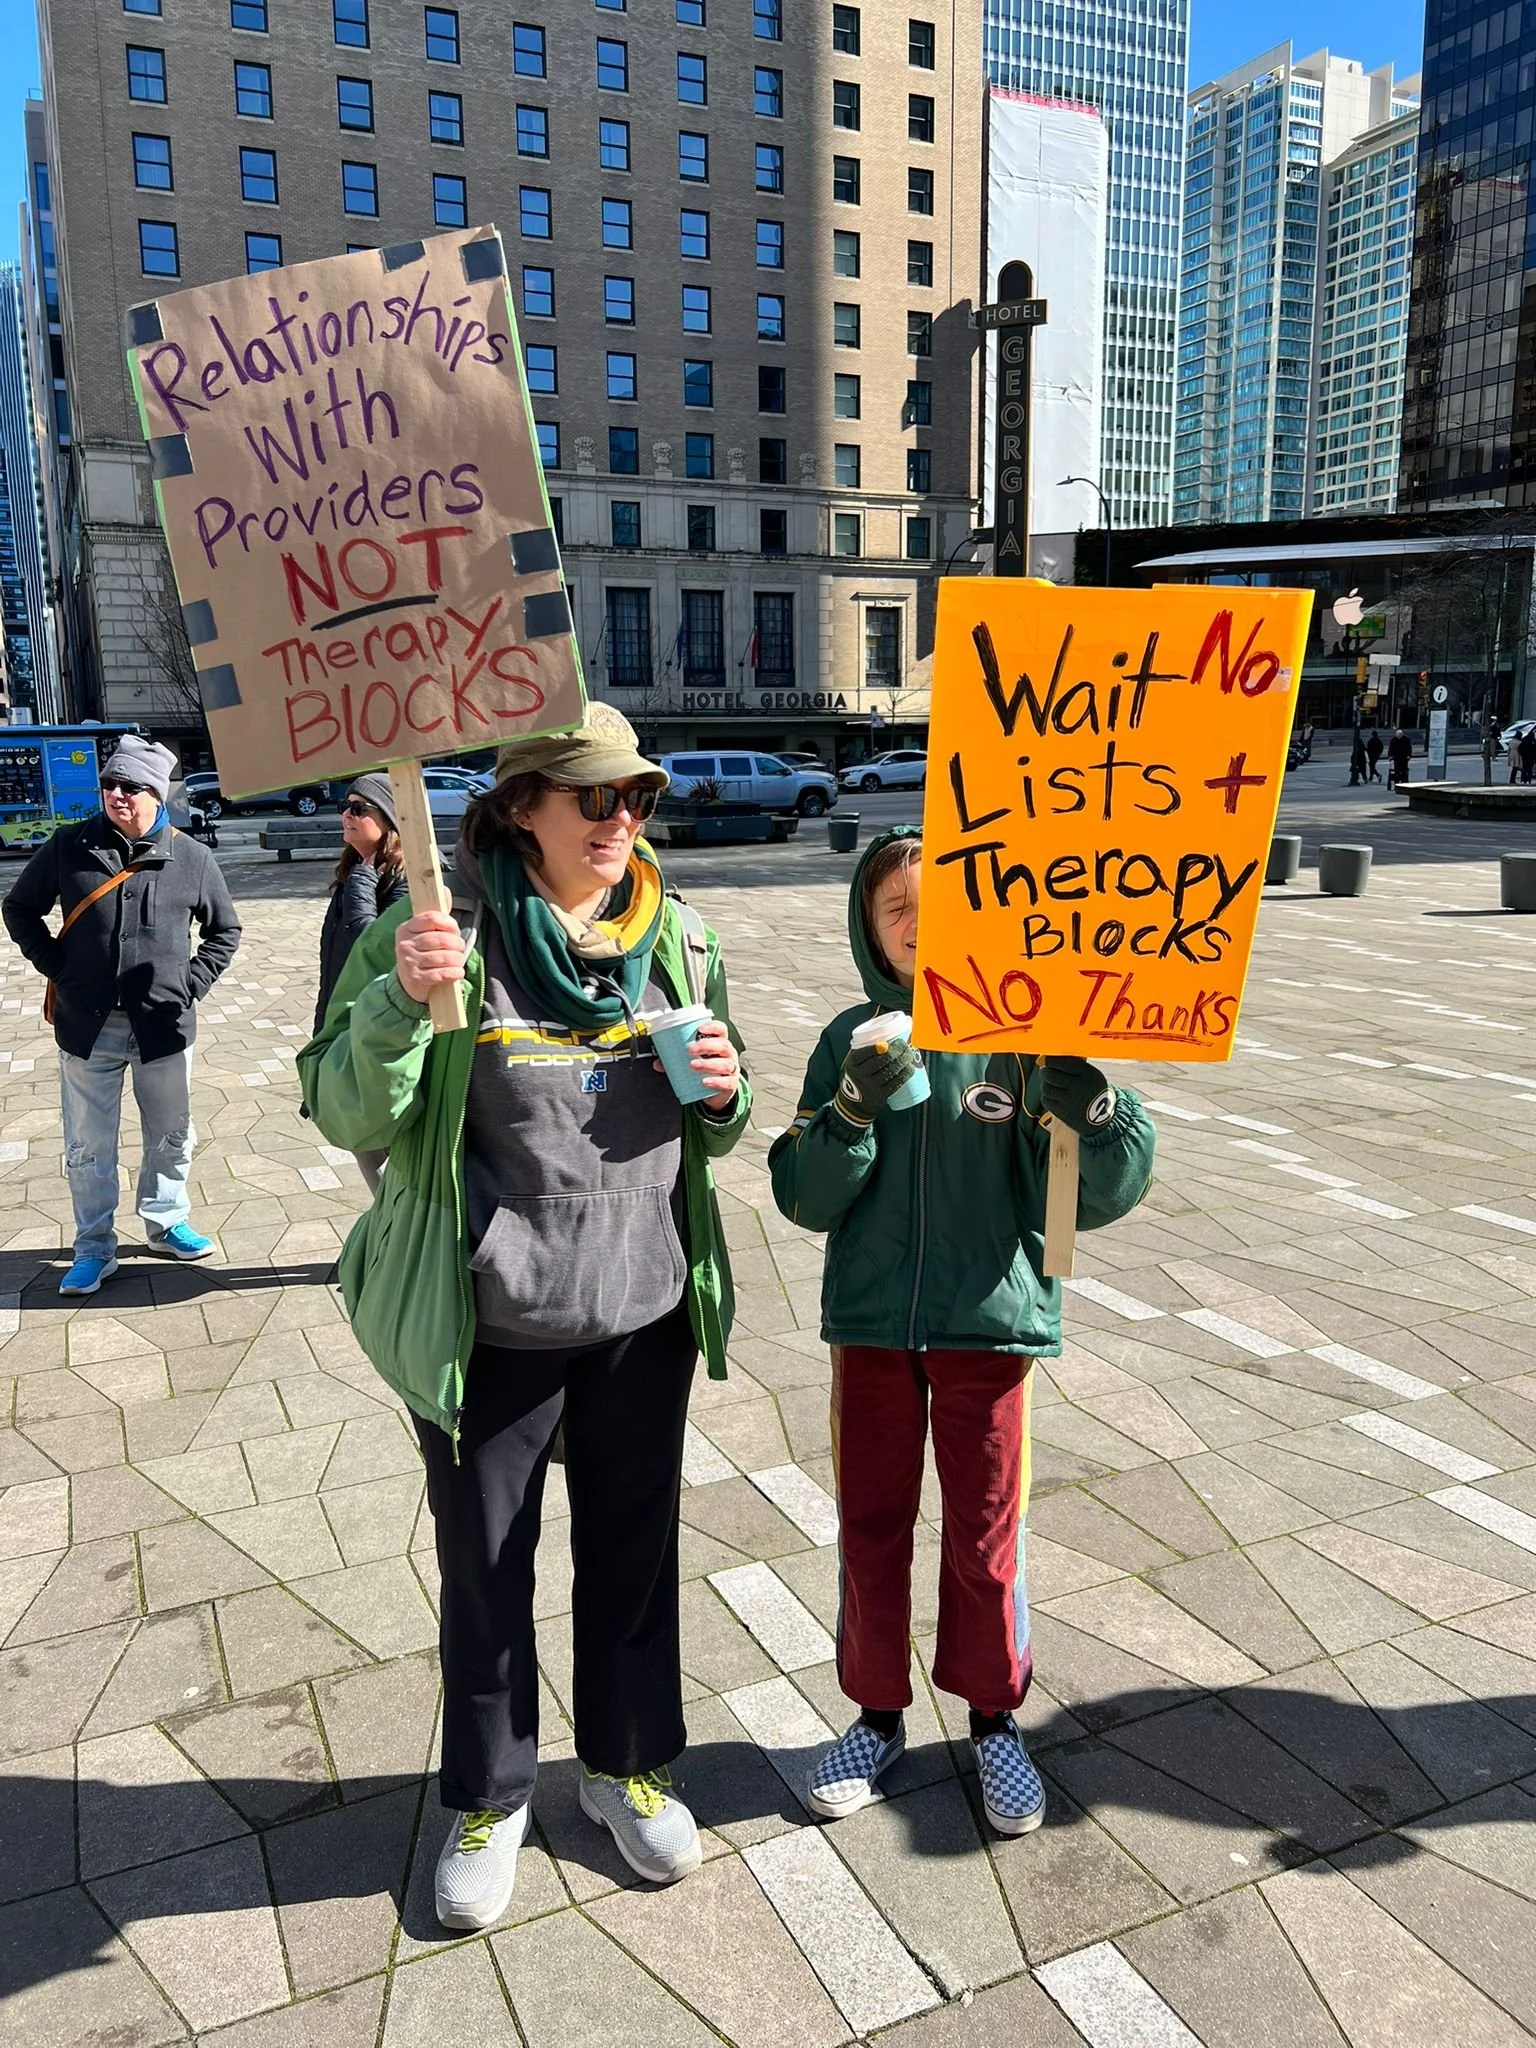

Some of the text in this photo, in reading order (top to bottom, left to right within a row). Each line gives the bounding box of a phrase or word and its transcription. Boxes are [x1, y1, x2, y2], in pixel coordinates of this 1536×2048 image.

[143, 271, 508, 431] Relationships
[985, 304, 1041, 321] HOTEL
[244, 367, 400, 485] With
[1000, 335, 1025, 557] GEORGIA
[194, 463, 485, 570] Providers
[280, 527, 473, 626] NOT
[262, 597, 503, 687] Therapy
[971, 609, 1281, 737] Wait No
[682, 692, 847, 708] HOTEL GEORGIA
[948, 741, 1182, 833] Lists
[935, 841, 1260, 922] Therapy
